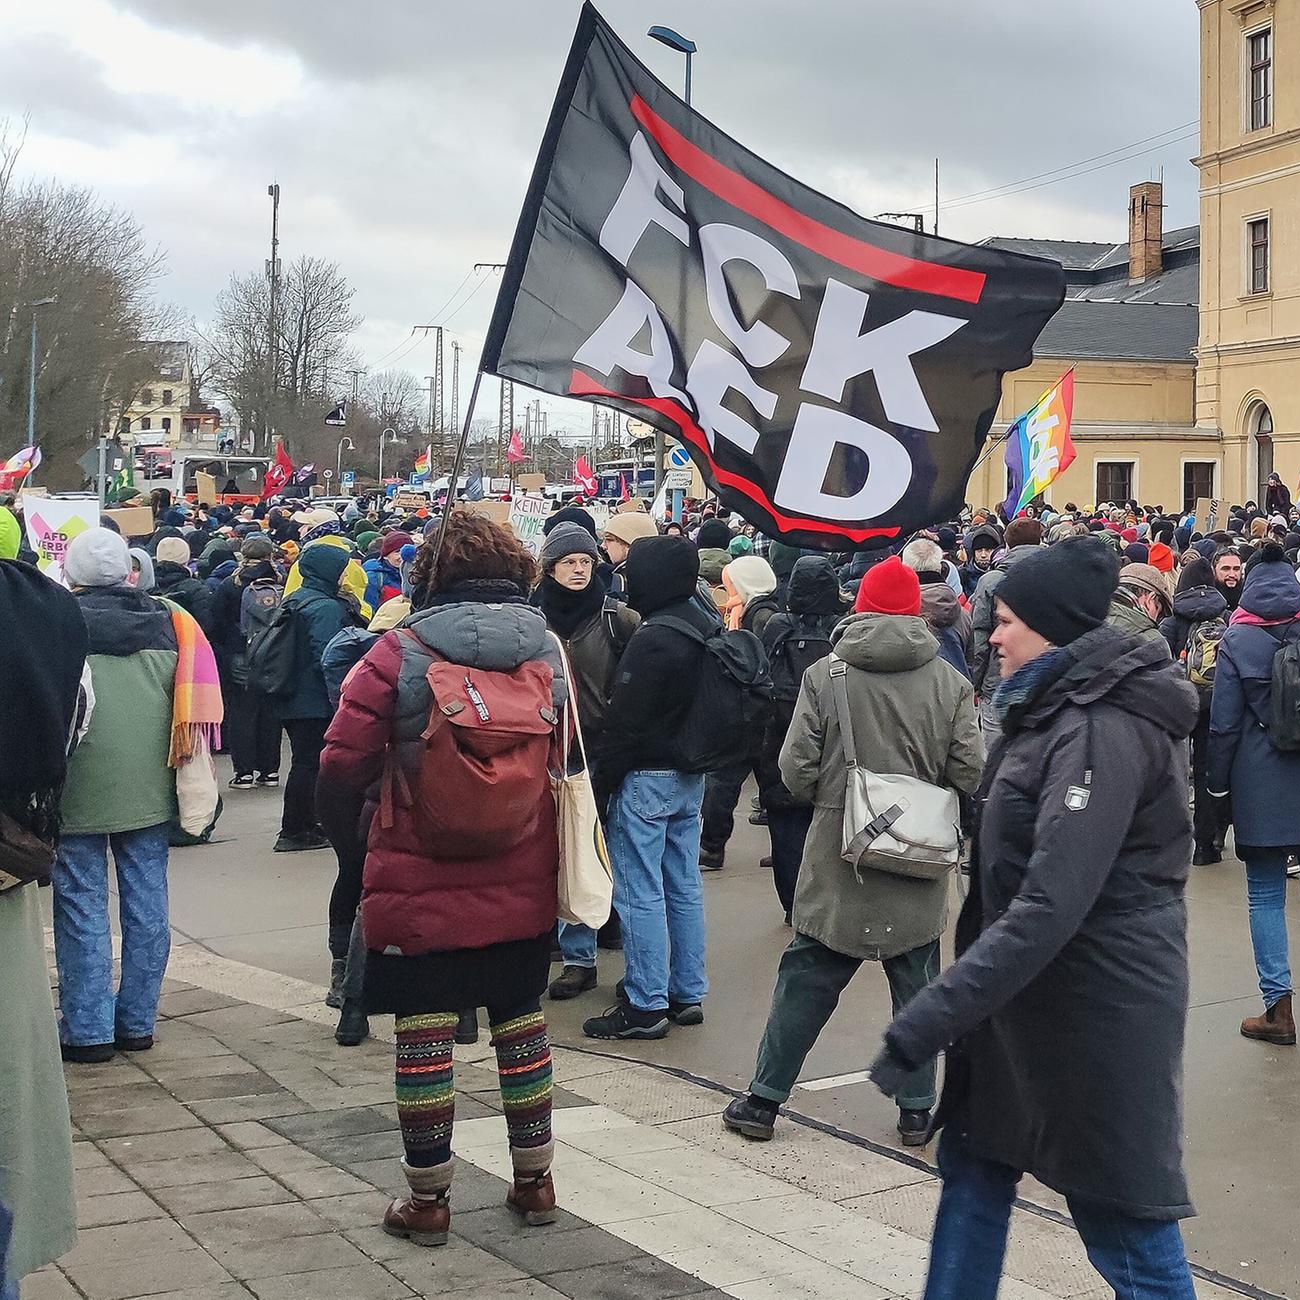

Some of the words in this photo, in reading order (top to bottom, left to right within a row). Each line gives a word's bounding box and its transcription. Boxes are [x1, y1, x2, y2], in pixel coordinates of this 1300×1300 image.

[599, 130, 969, 433] FCK
[572, 277, 914, 523] AFD
[513, 497, 549, 515] KEINE
[36, 538, 69, 552] VERB
[43, 532, 68, 541] AFD
